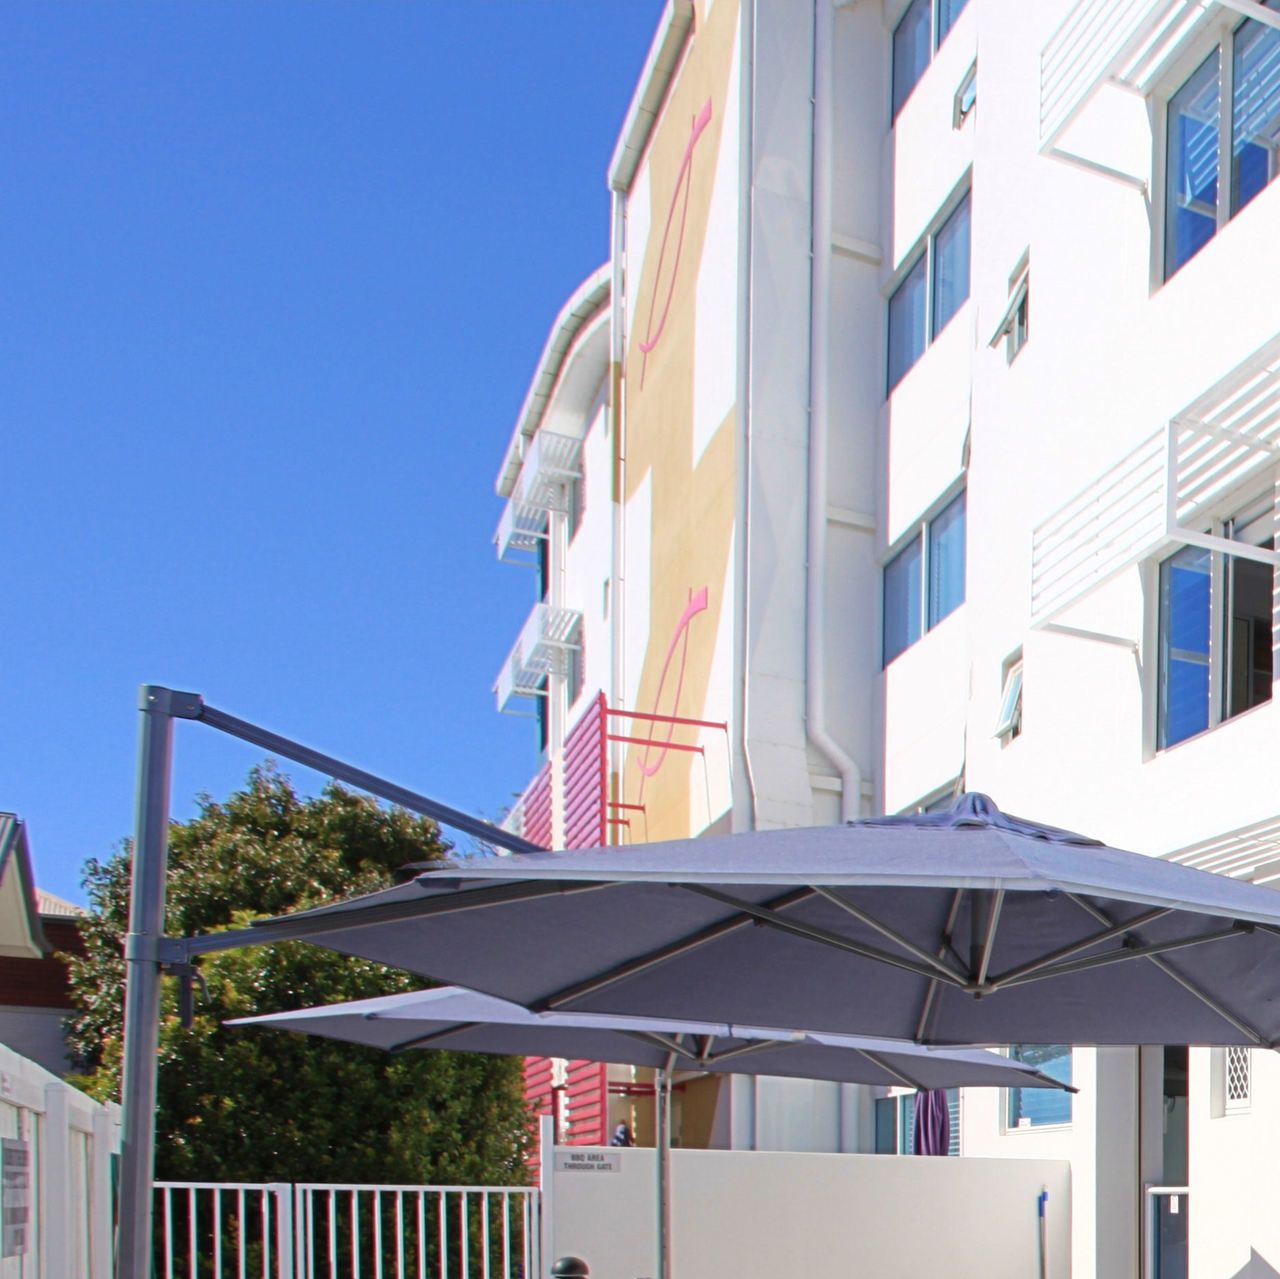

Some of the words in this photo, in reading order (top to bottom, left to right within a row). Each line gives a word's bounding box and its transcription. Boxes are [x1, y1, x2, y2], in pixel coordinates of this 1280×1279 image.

[587, 1154, 605, 1162] AREA
[563, 1162, 595, 1170] THROUGH
[596, 1163, 612, 1171] GATE
